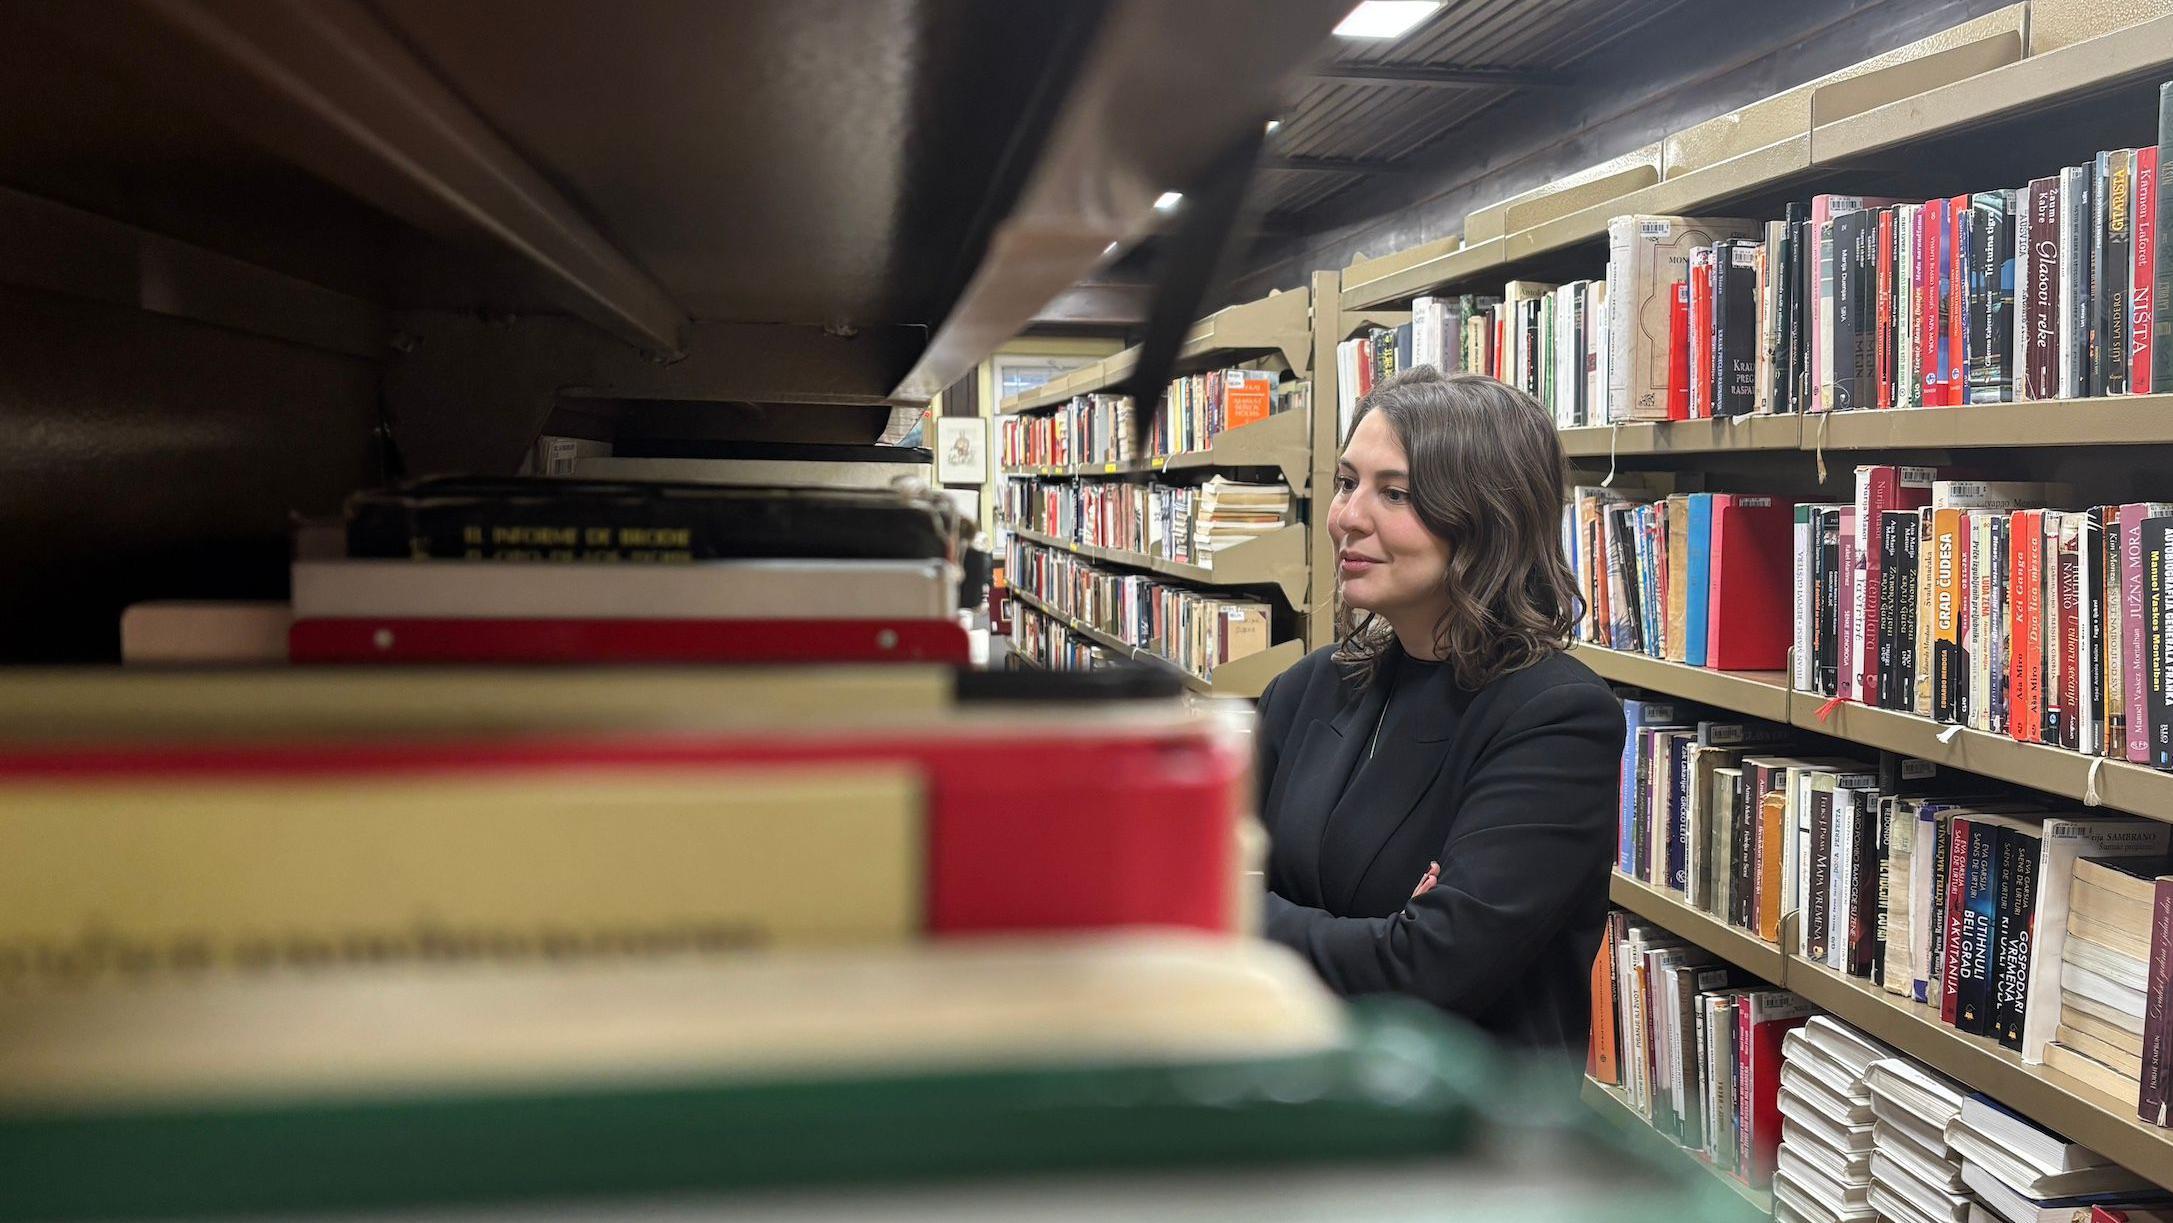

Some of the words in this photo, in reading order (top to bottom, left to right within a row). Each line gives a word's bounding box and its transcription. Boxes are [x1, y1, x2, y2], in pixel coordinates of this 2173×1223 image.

[2110, 168, 2126, 231] GITARISTA
[2137, 169, 2151, 219] Karmen
[2136, 221, 2149, 266] Laforet
[2036, 240, 2058, 306] Glasovi
[2036, 313, 2055, 348] reke
[2112, 292, 2122, 339] LANDERO
[2132, 286, 2152, 356] NIŠTA
[2112, 340, 2122, 363] LUIS
[1935, 531, 1953, 589] ČUDESA
[2109, 532, 2118, 551] Kim
[2128, 525, 2141, 569] MORA
[2062, 562, 2072, 610] NAVARO
[2151, 550, 2160, 592] Manuel
[1938, 591, 1952, 630] GRAD
[2127, 574, 2142, 620] JUŽNA
[2151, 593, 2161, 632] Vaskes
[2016, 653, 2024, 679] Miro
[2030, 666, 2038, 692] Miro
[2152, 633, 2161, 692] Montalban
[2164, 665, 2173, 707] FRANKA
[2133, 704, 2144, 734] Manuel
[1960, 839, 1968, 855] EVA
[1972, 858, 1980, 868] DE
[1973, 832, 1982, 857] SAENS
[1981, 843, 1990, 859] EVA
[1816, 853, 1828, 887] MAPA
[1970, 870, 1979, 899] URTURI
[1979, 860, 1989, 891] GARSIJA
[1813, 889, 1825, 941] VREMENA
[1962, 909, 1976, 937] BELI
[1947, 917, 1962, 996] AKVITANIJA
[1960, 939, 1974, 979] GRAD
[1974, 915, 1990, 980] UTIHNULI
[2003, 938, 2020, 1003] VREMENA
[2013, 930, 2030, 1014] GOSPODARI
